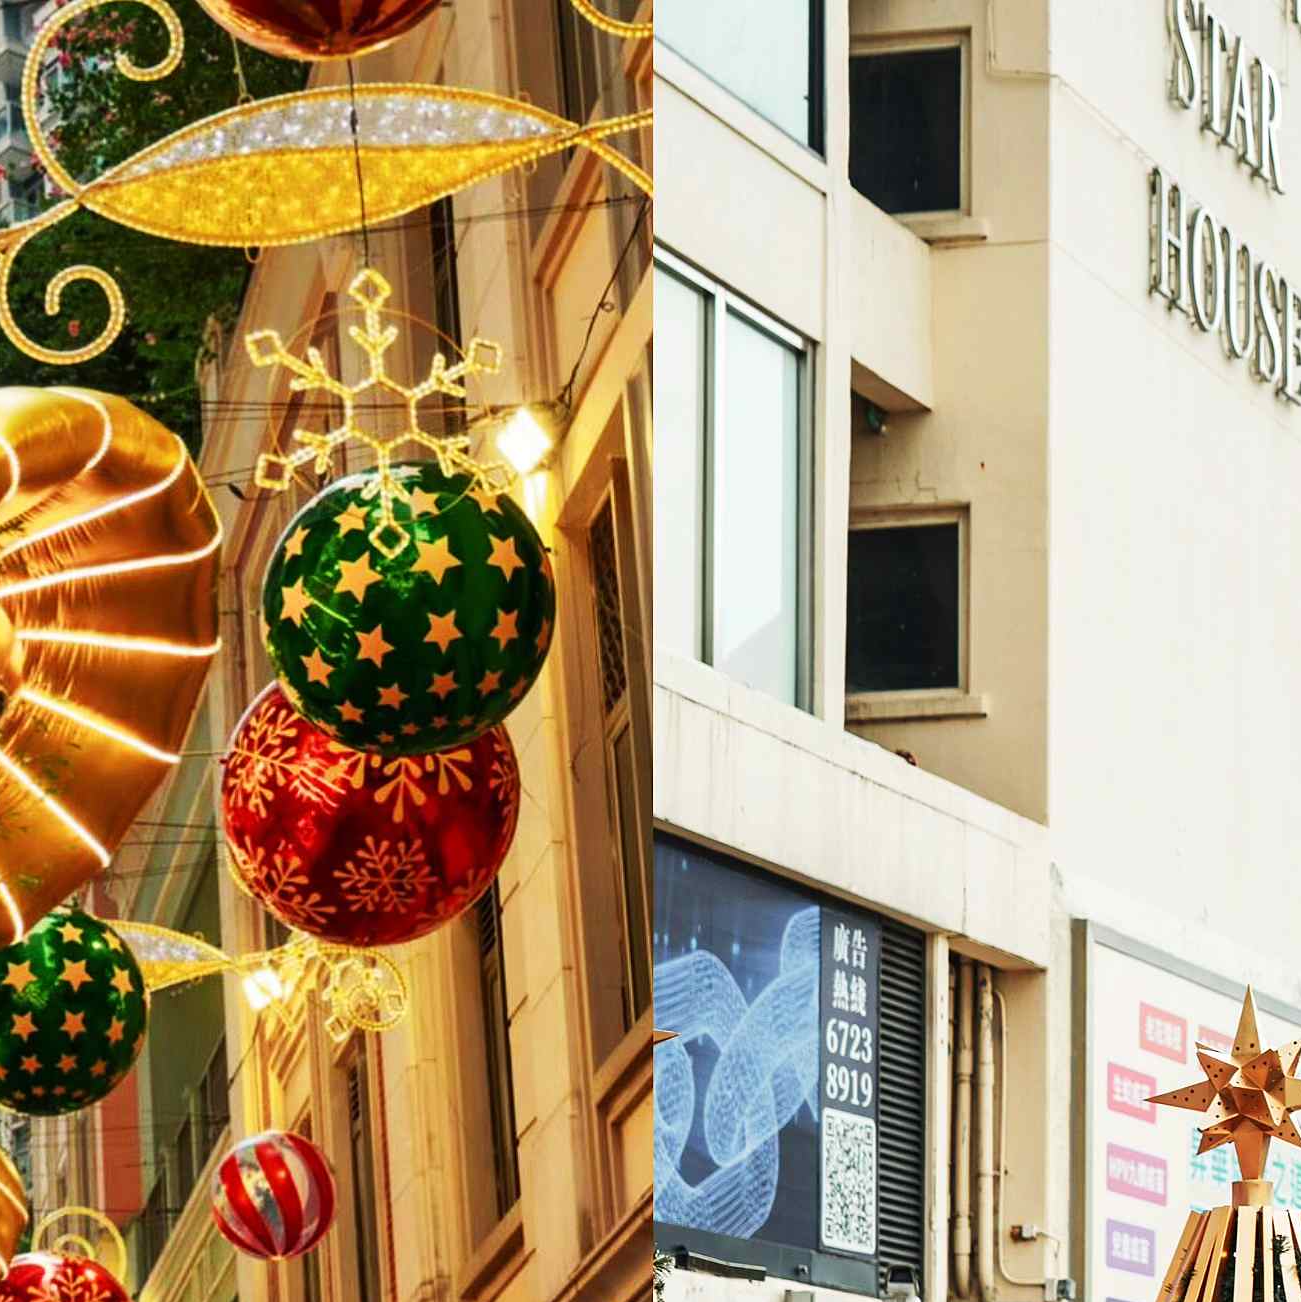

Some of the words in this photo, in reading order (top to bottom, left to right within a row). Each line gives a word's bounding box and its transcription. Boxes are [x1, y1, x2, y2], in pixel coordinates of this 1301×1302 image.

[1167, 0, 1285, 195] STAR
[833, 923, 868, 970] 廣告
[825, 1018, 873, 1064] 6723
[825, 1063, 873, 1108] 8919
